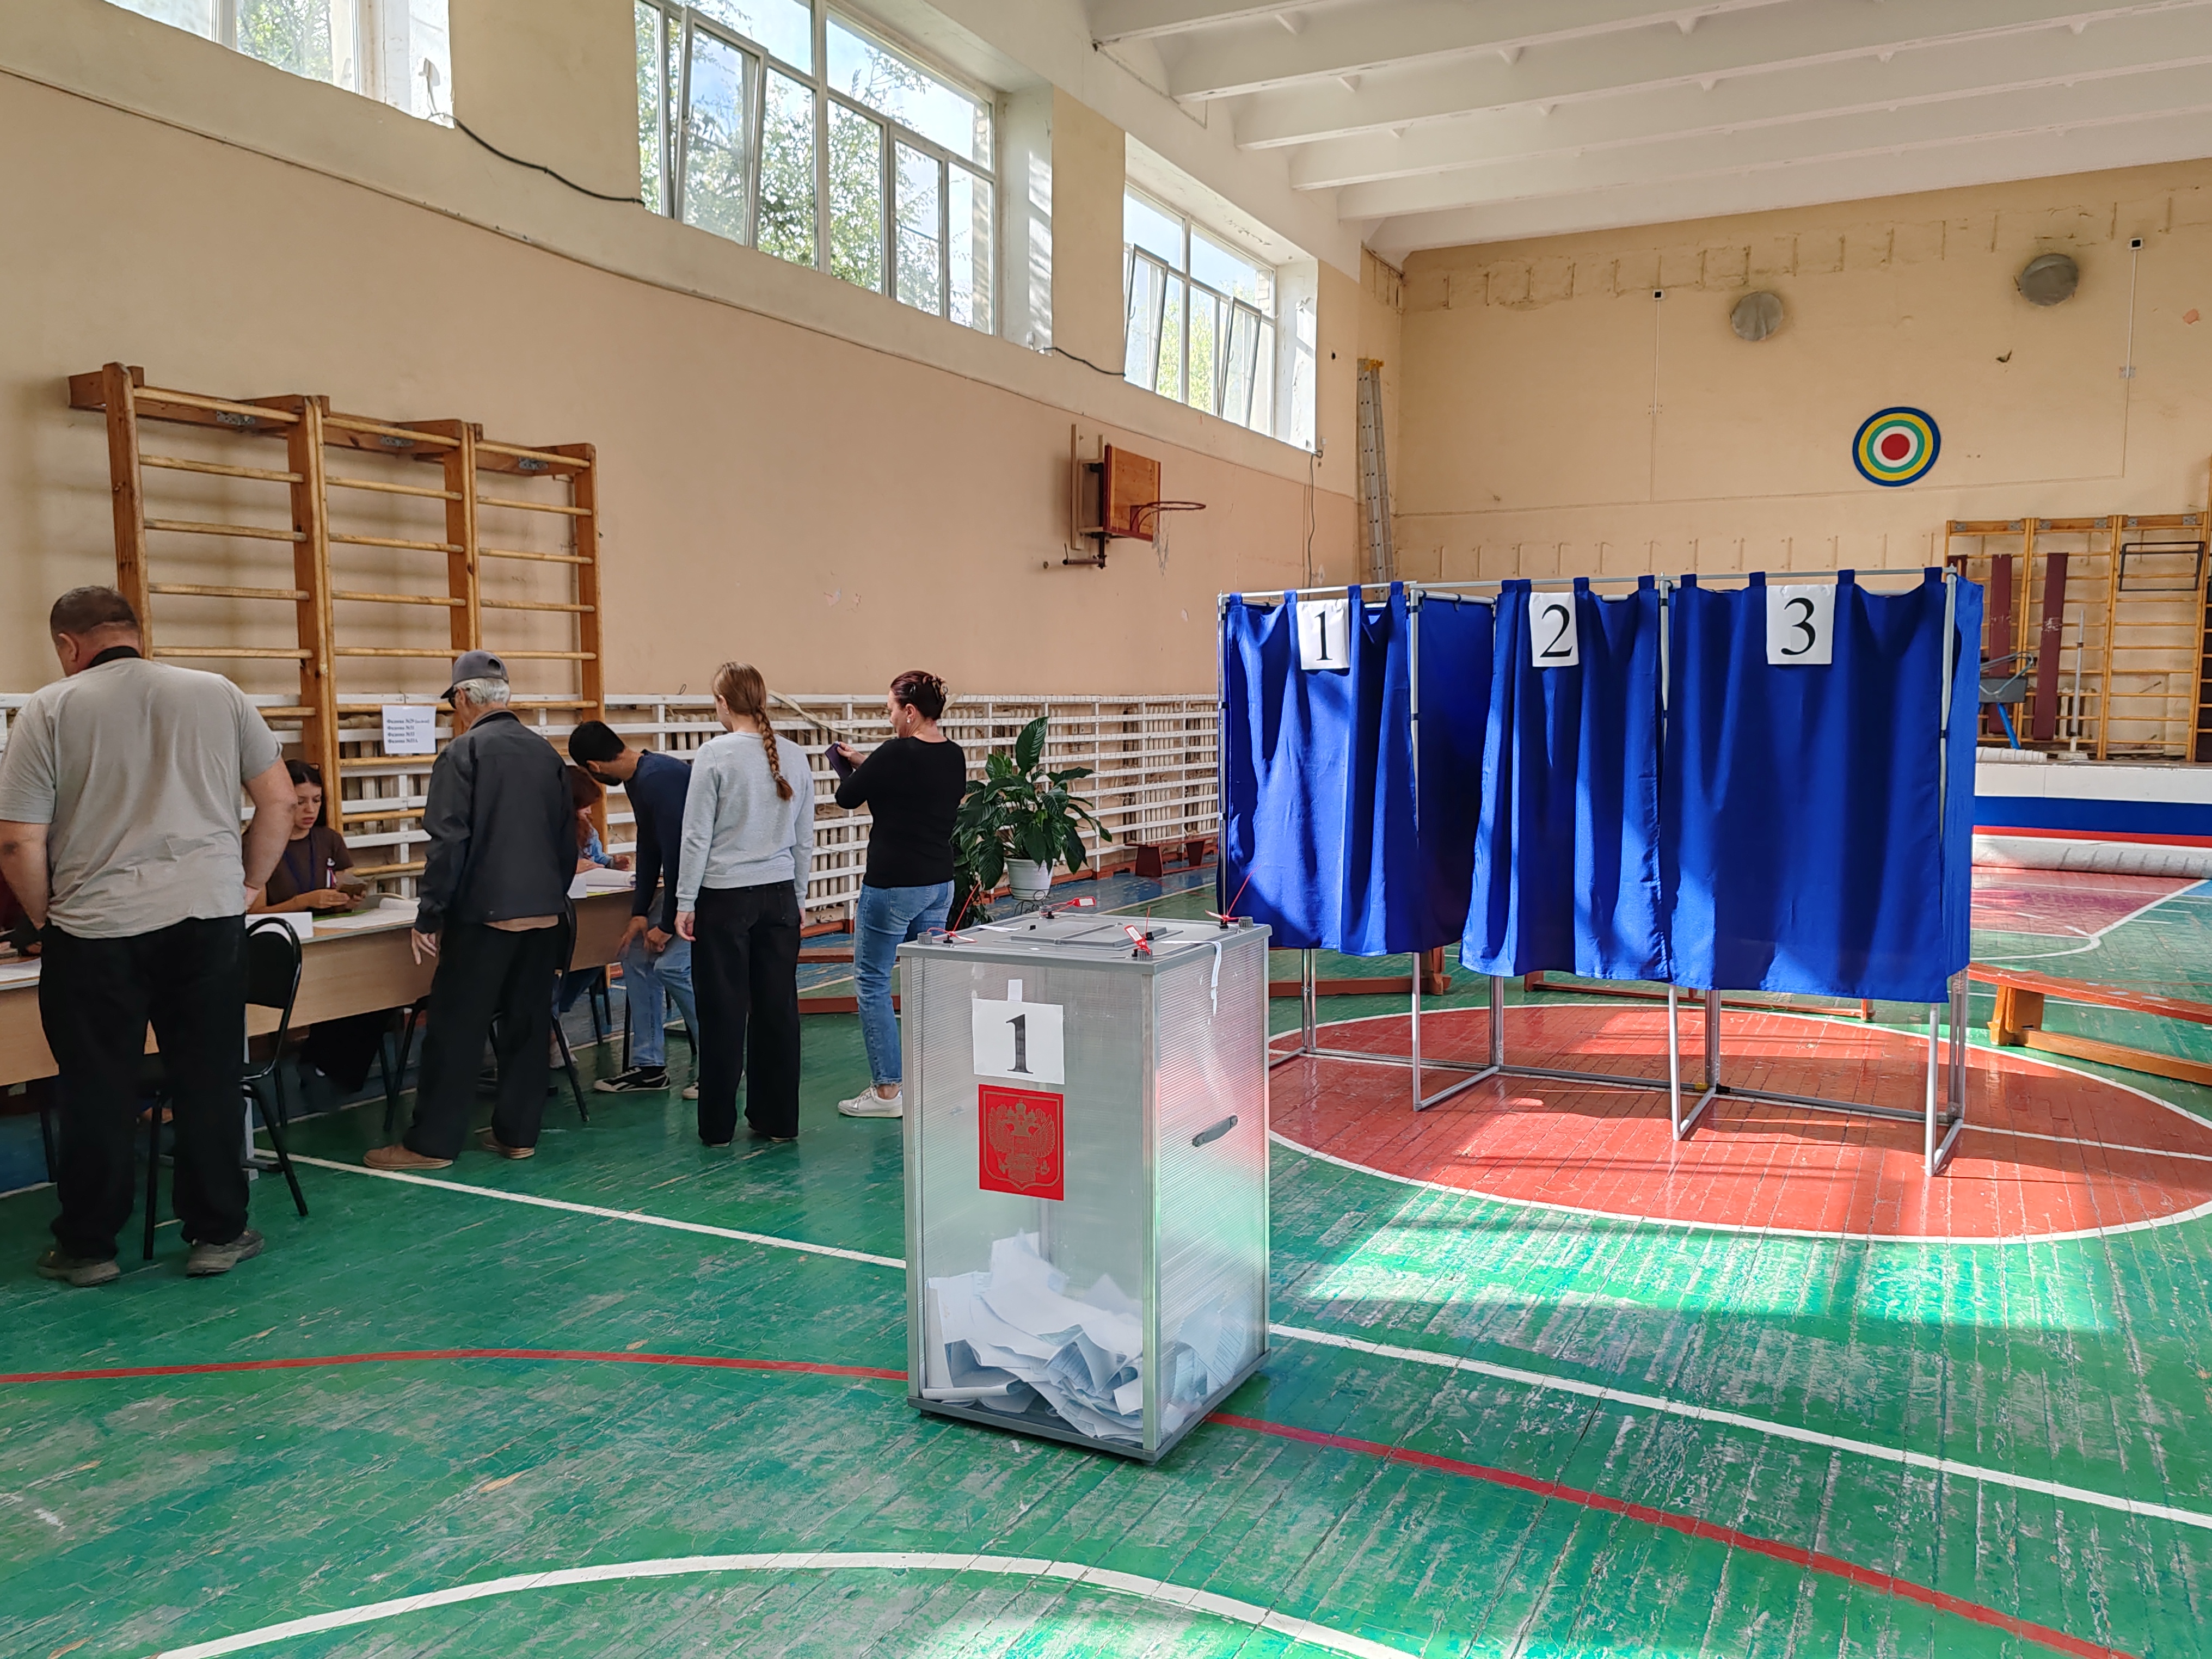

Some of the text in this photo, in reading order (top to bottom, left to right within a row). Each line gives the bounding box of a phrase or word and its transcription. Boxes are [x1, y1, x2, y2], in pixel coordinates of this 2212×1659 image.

[1314, 610, 1333, 661] 1
[1539, 604, 1573, 658] 2
[1780, 597, 1816, 655] 3
[1005, 1013, 1034, 1074] 1
